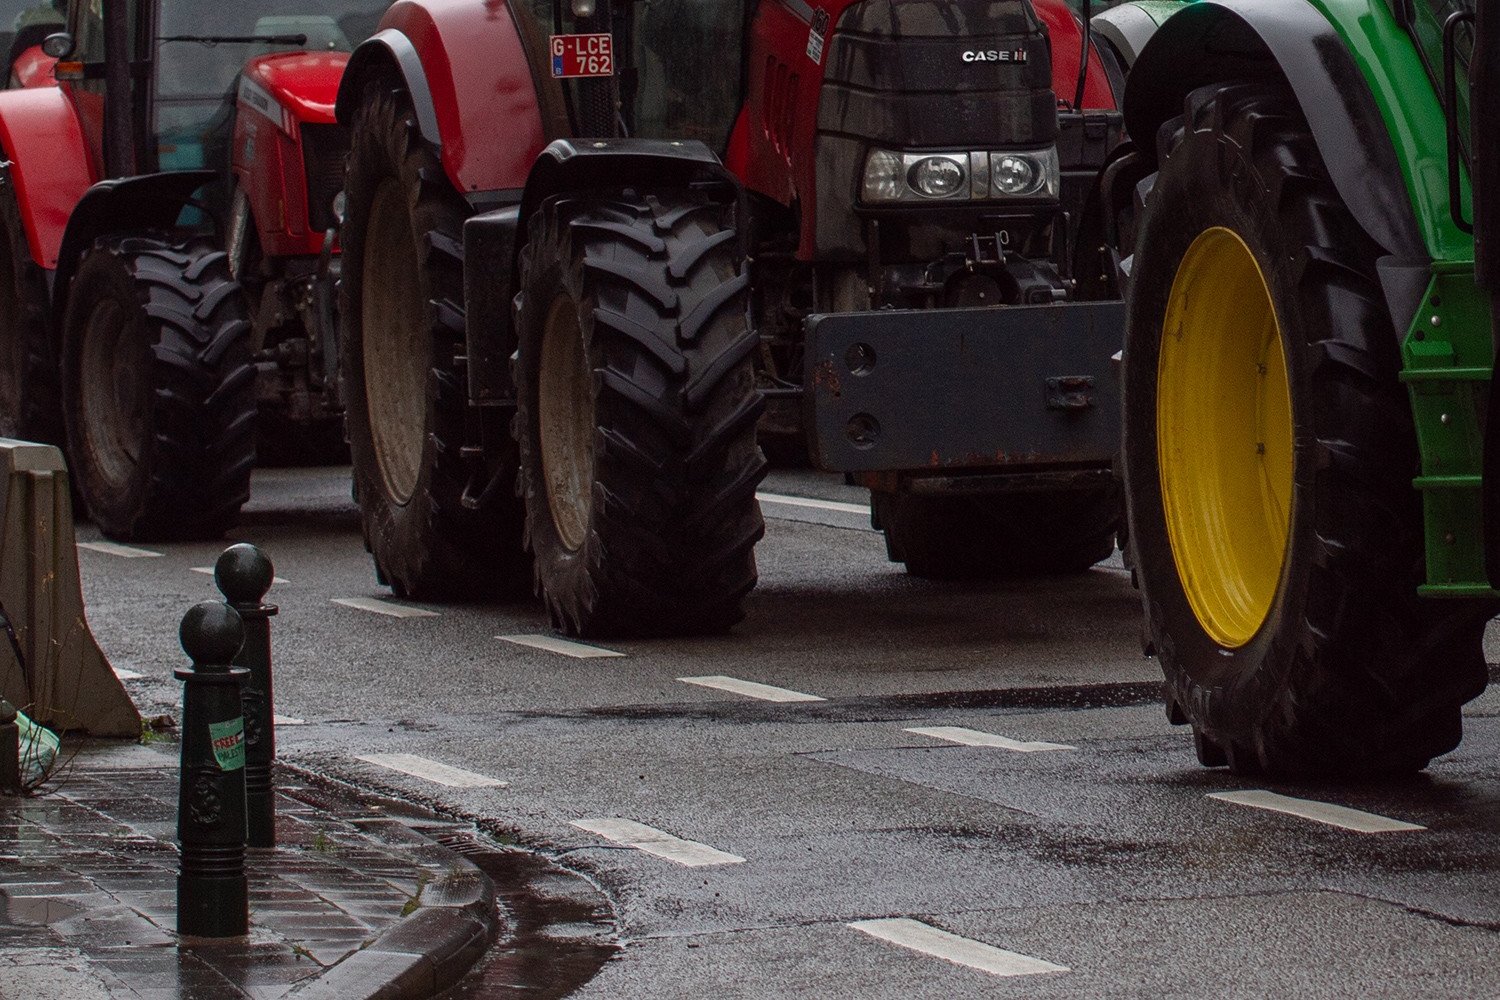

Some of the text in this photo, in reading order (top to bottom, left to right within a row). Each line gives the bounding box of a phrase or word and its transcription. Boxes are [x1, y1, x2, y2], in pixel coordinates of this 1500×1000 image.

[553, 36, 610, 56] G-LCE
[576, 55, 611, 74] 762
[962, 50, 1010, 62] CASE
